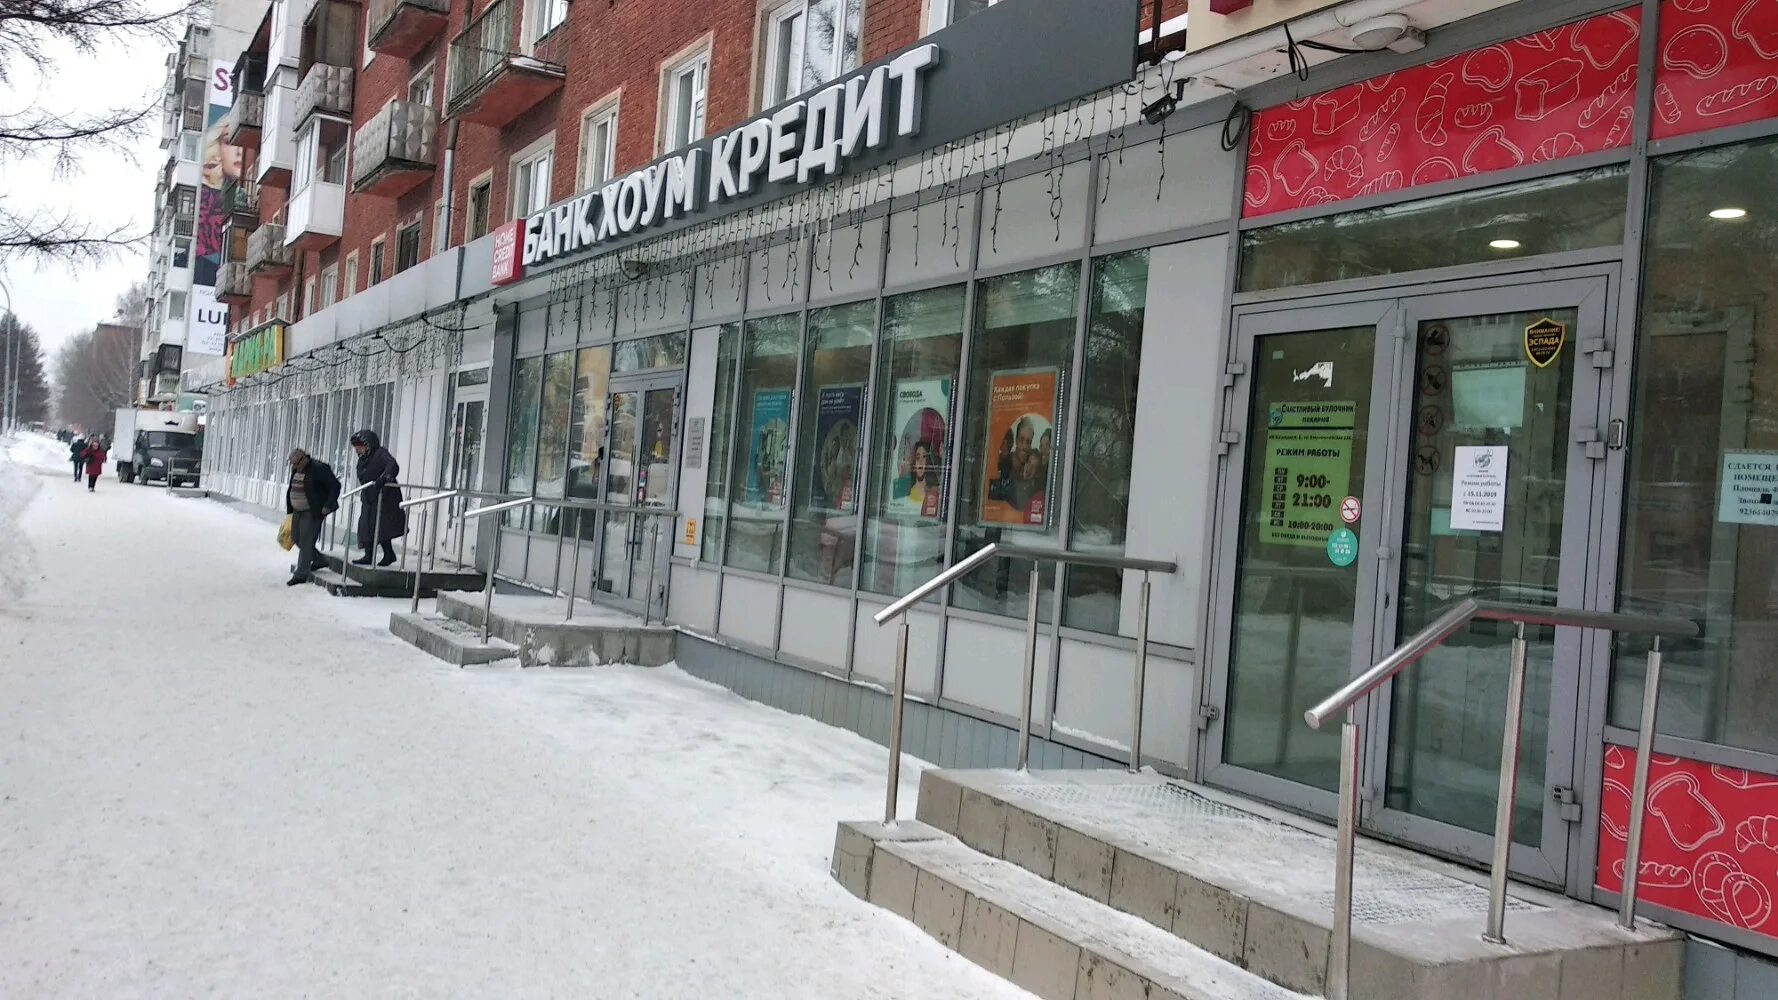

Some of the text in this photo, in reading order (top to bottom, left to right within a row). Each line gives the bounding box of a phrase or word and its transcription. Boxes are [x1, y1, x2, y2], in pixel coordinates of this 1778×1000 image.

[522, 43, 940, 266] БАНК ХОУМ КРЕДИТ
[494, 228, 514, 249] HOME
[493, 242, 514, 263] CREDIT
[491, 259, 509, 280] BANK
[1529, 337, 1560, 346] ЭСПАДА
[899, 390, 923, 399] СВОБОДА
[1015, 383, 1040, 392] покупка
[1276, 448, 1340, 458] РЕЖИМ РАБОТЫ
[1296, 474, 1331, 489] 9:00-
[1292, 493, 1332, 508] 21:00
[1287, 519, 1334, 531] 10:00-20:00
